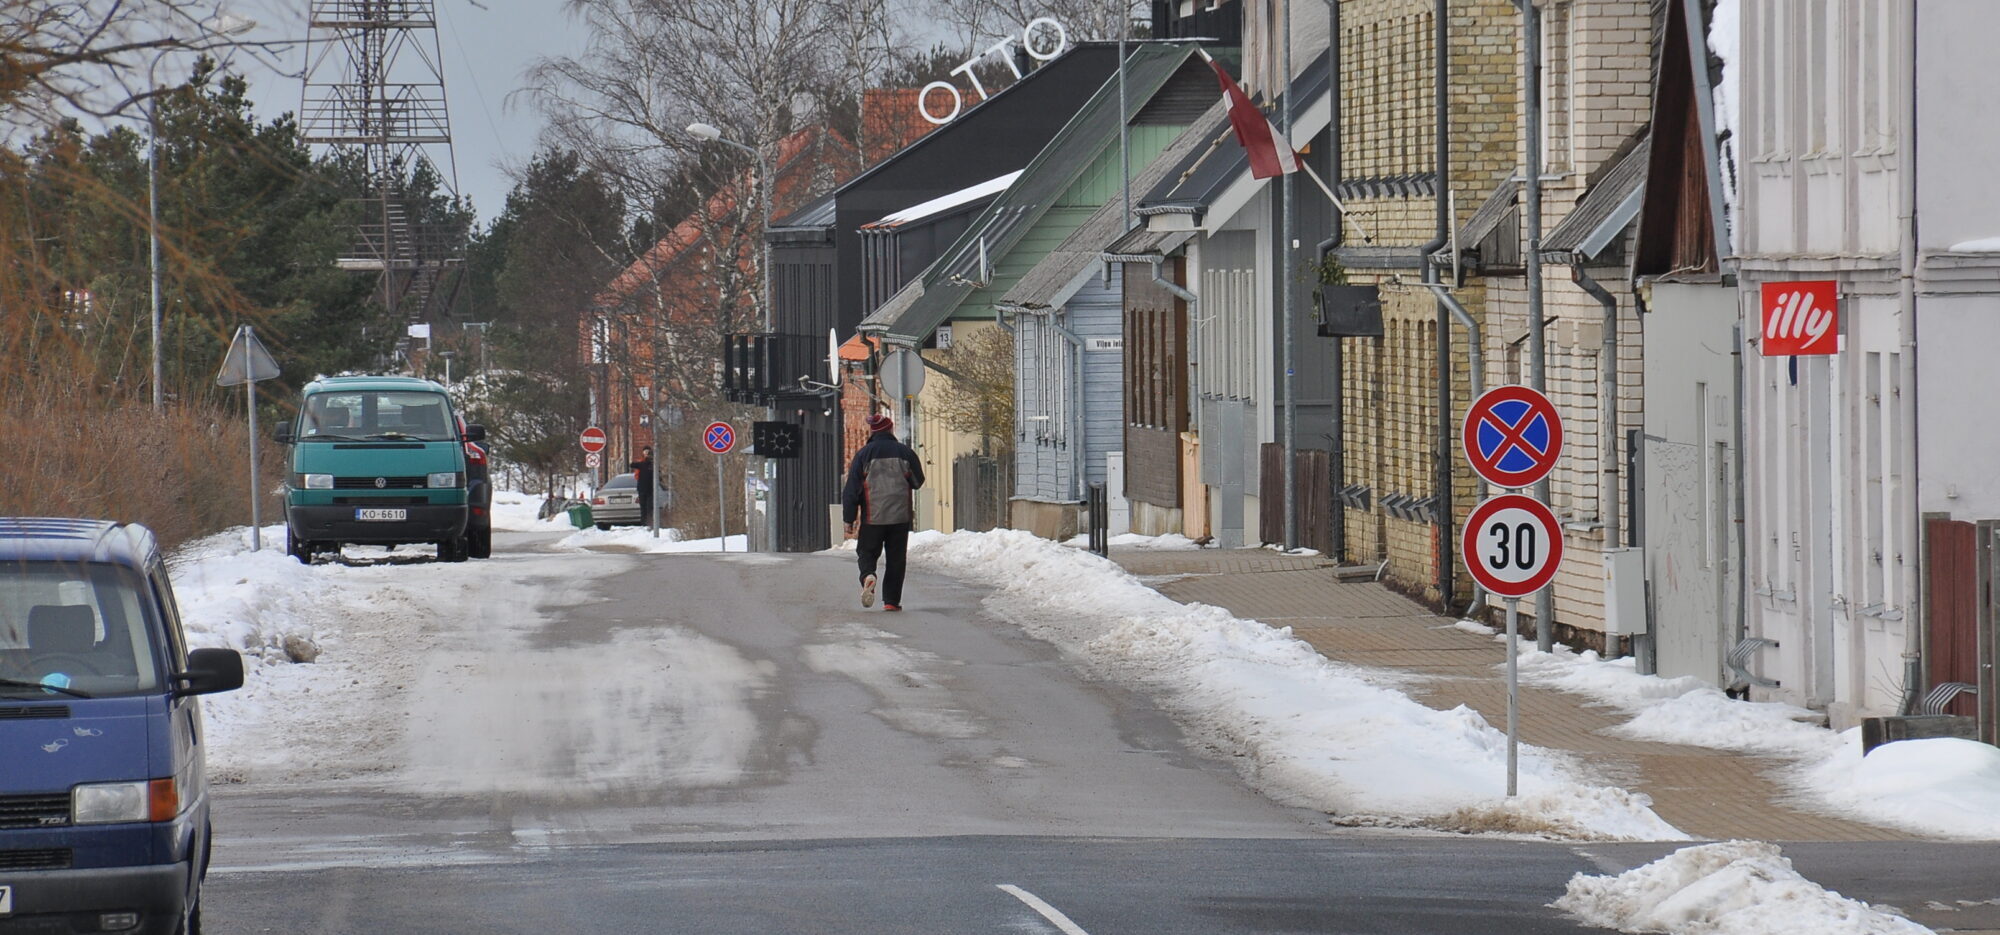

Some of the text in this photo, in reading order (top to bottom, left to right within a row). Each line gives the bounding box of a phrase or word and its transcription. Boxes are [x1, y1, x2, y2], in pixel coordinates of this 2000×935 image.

[918, 17, 1066, 124] OTTO
[1766, 290, 1833, 350] illy
[939, 333, 949, 343] 13
[362, 510, 405, 519] KO-6610
[1489, 522, 1536, 570] 30
[38, 817, 67, 825] TDI
